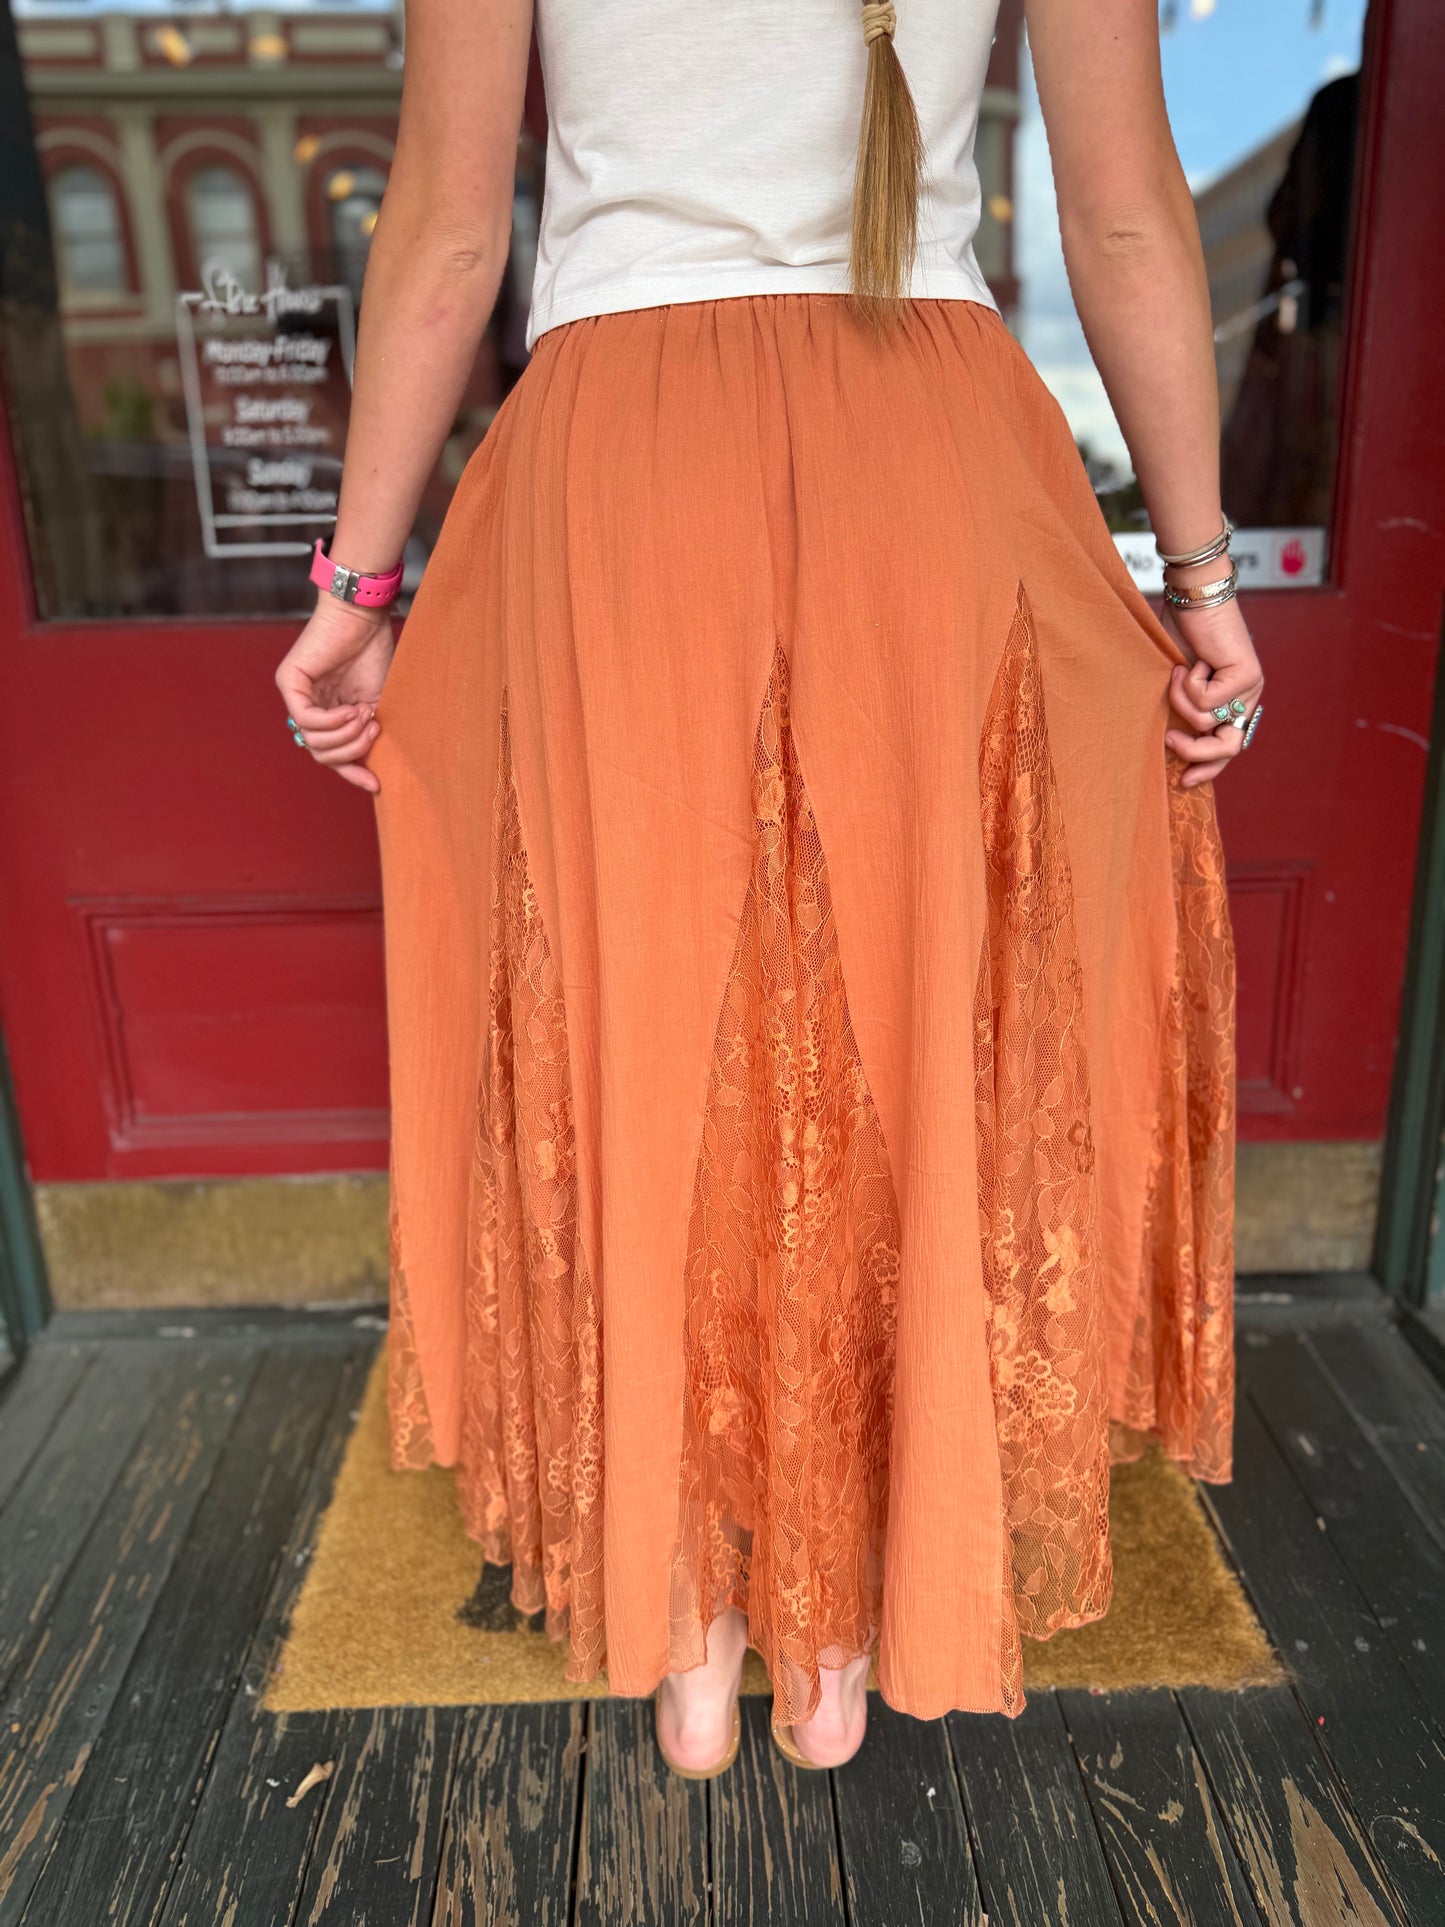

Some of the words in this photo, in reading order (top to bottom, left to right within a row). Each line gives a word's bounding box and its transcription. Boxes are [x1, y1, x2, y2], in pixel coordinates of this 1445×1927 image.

[236, 396, 311, 425] Saturday
[248, 457, 313, 490] Sunday
[1124, 551, 1154, 569] No
